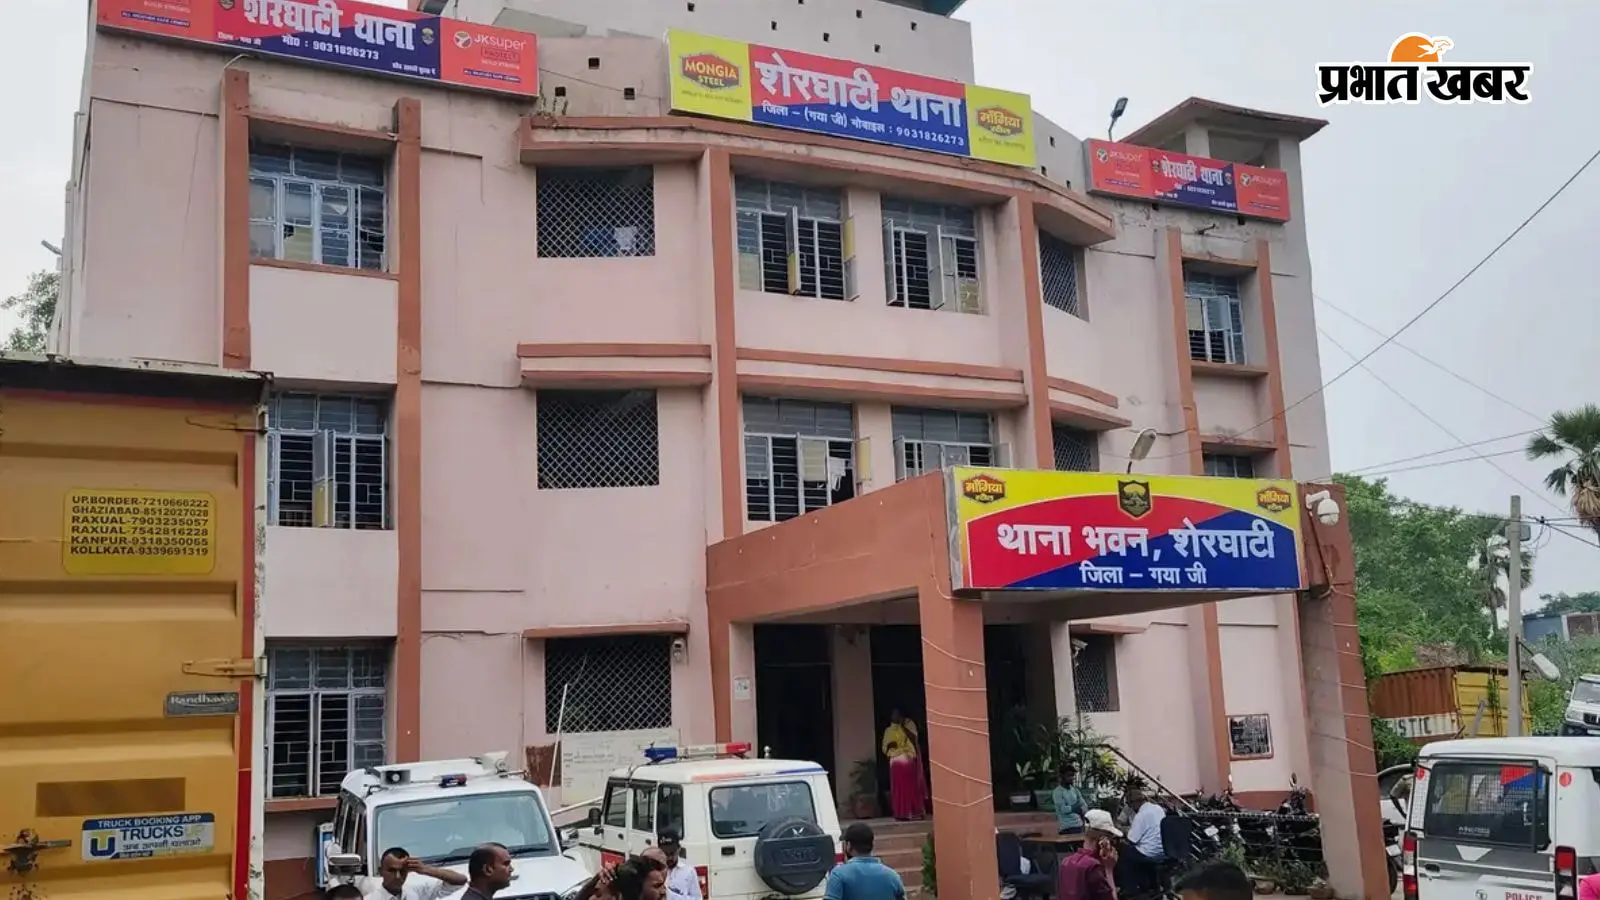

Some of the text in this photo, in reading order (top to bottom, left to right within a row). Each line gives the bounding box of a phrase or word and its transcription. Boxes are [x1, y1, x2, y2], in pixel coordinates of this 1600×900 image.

[243, 0, 417, 51] शरघाटी थाना
[312, 40, 379, 60] 9031826273
[698, 75, 725, 87] STEEL
[754, 51, 962, 127] शेरघाटी थाना
[761, 99, 789, 116] जिला
[804, 106, 828, 123] (गया
[830, 111, 848, 128] जी)
[895, 126, 965, 146] 9031826273
[997, 523, 1072, 556] थाना
[1167, 517, 1276, 559] शेरघाटी
[1078, 560, 1123, 585] जिला
[1148, 565, 1181, 585] गया
[1186, 561, 1207, 585] जी
[98, 814, 202, 828] TRUCK BOOKING APP
